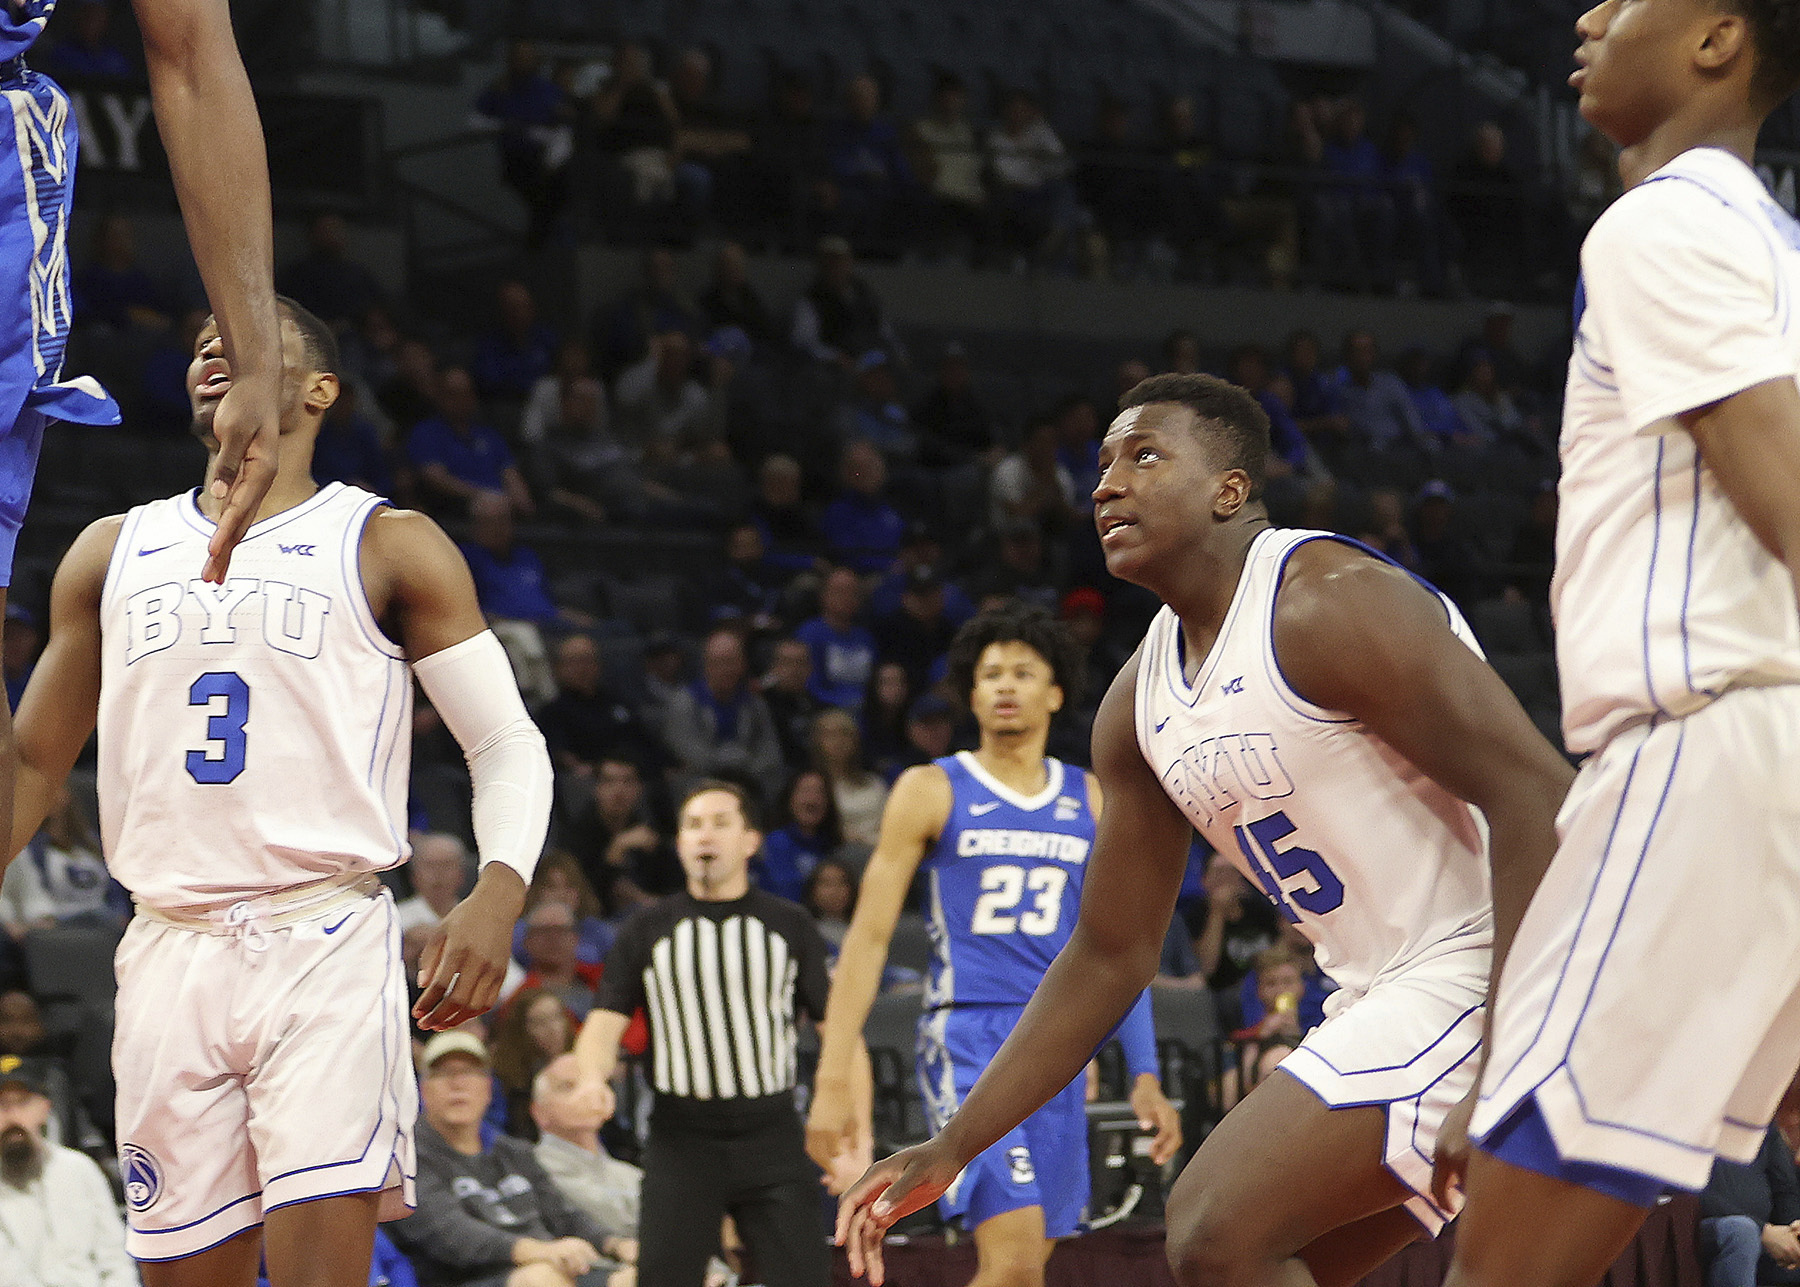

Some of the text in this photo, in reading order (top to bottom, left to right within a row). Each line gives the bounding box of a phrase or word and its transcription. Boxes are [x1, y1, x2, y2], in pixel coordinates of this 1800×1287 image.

[126, 577, 332, 666] BYU
[185, 672, 250, 785] 3
[957, 829, 1090, 865] CREIGHTON
[1233, 810, 1345, 925] 15
[971, 864, 1070, 937] 23
